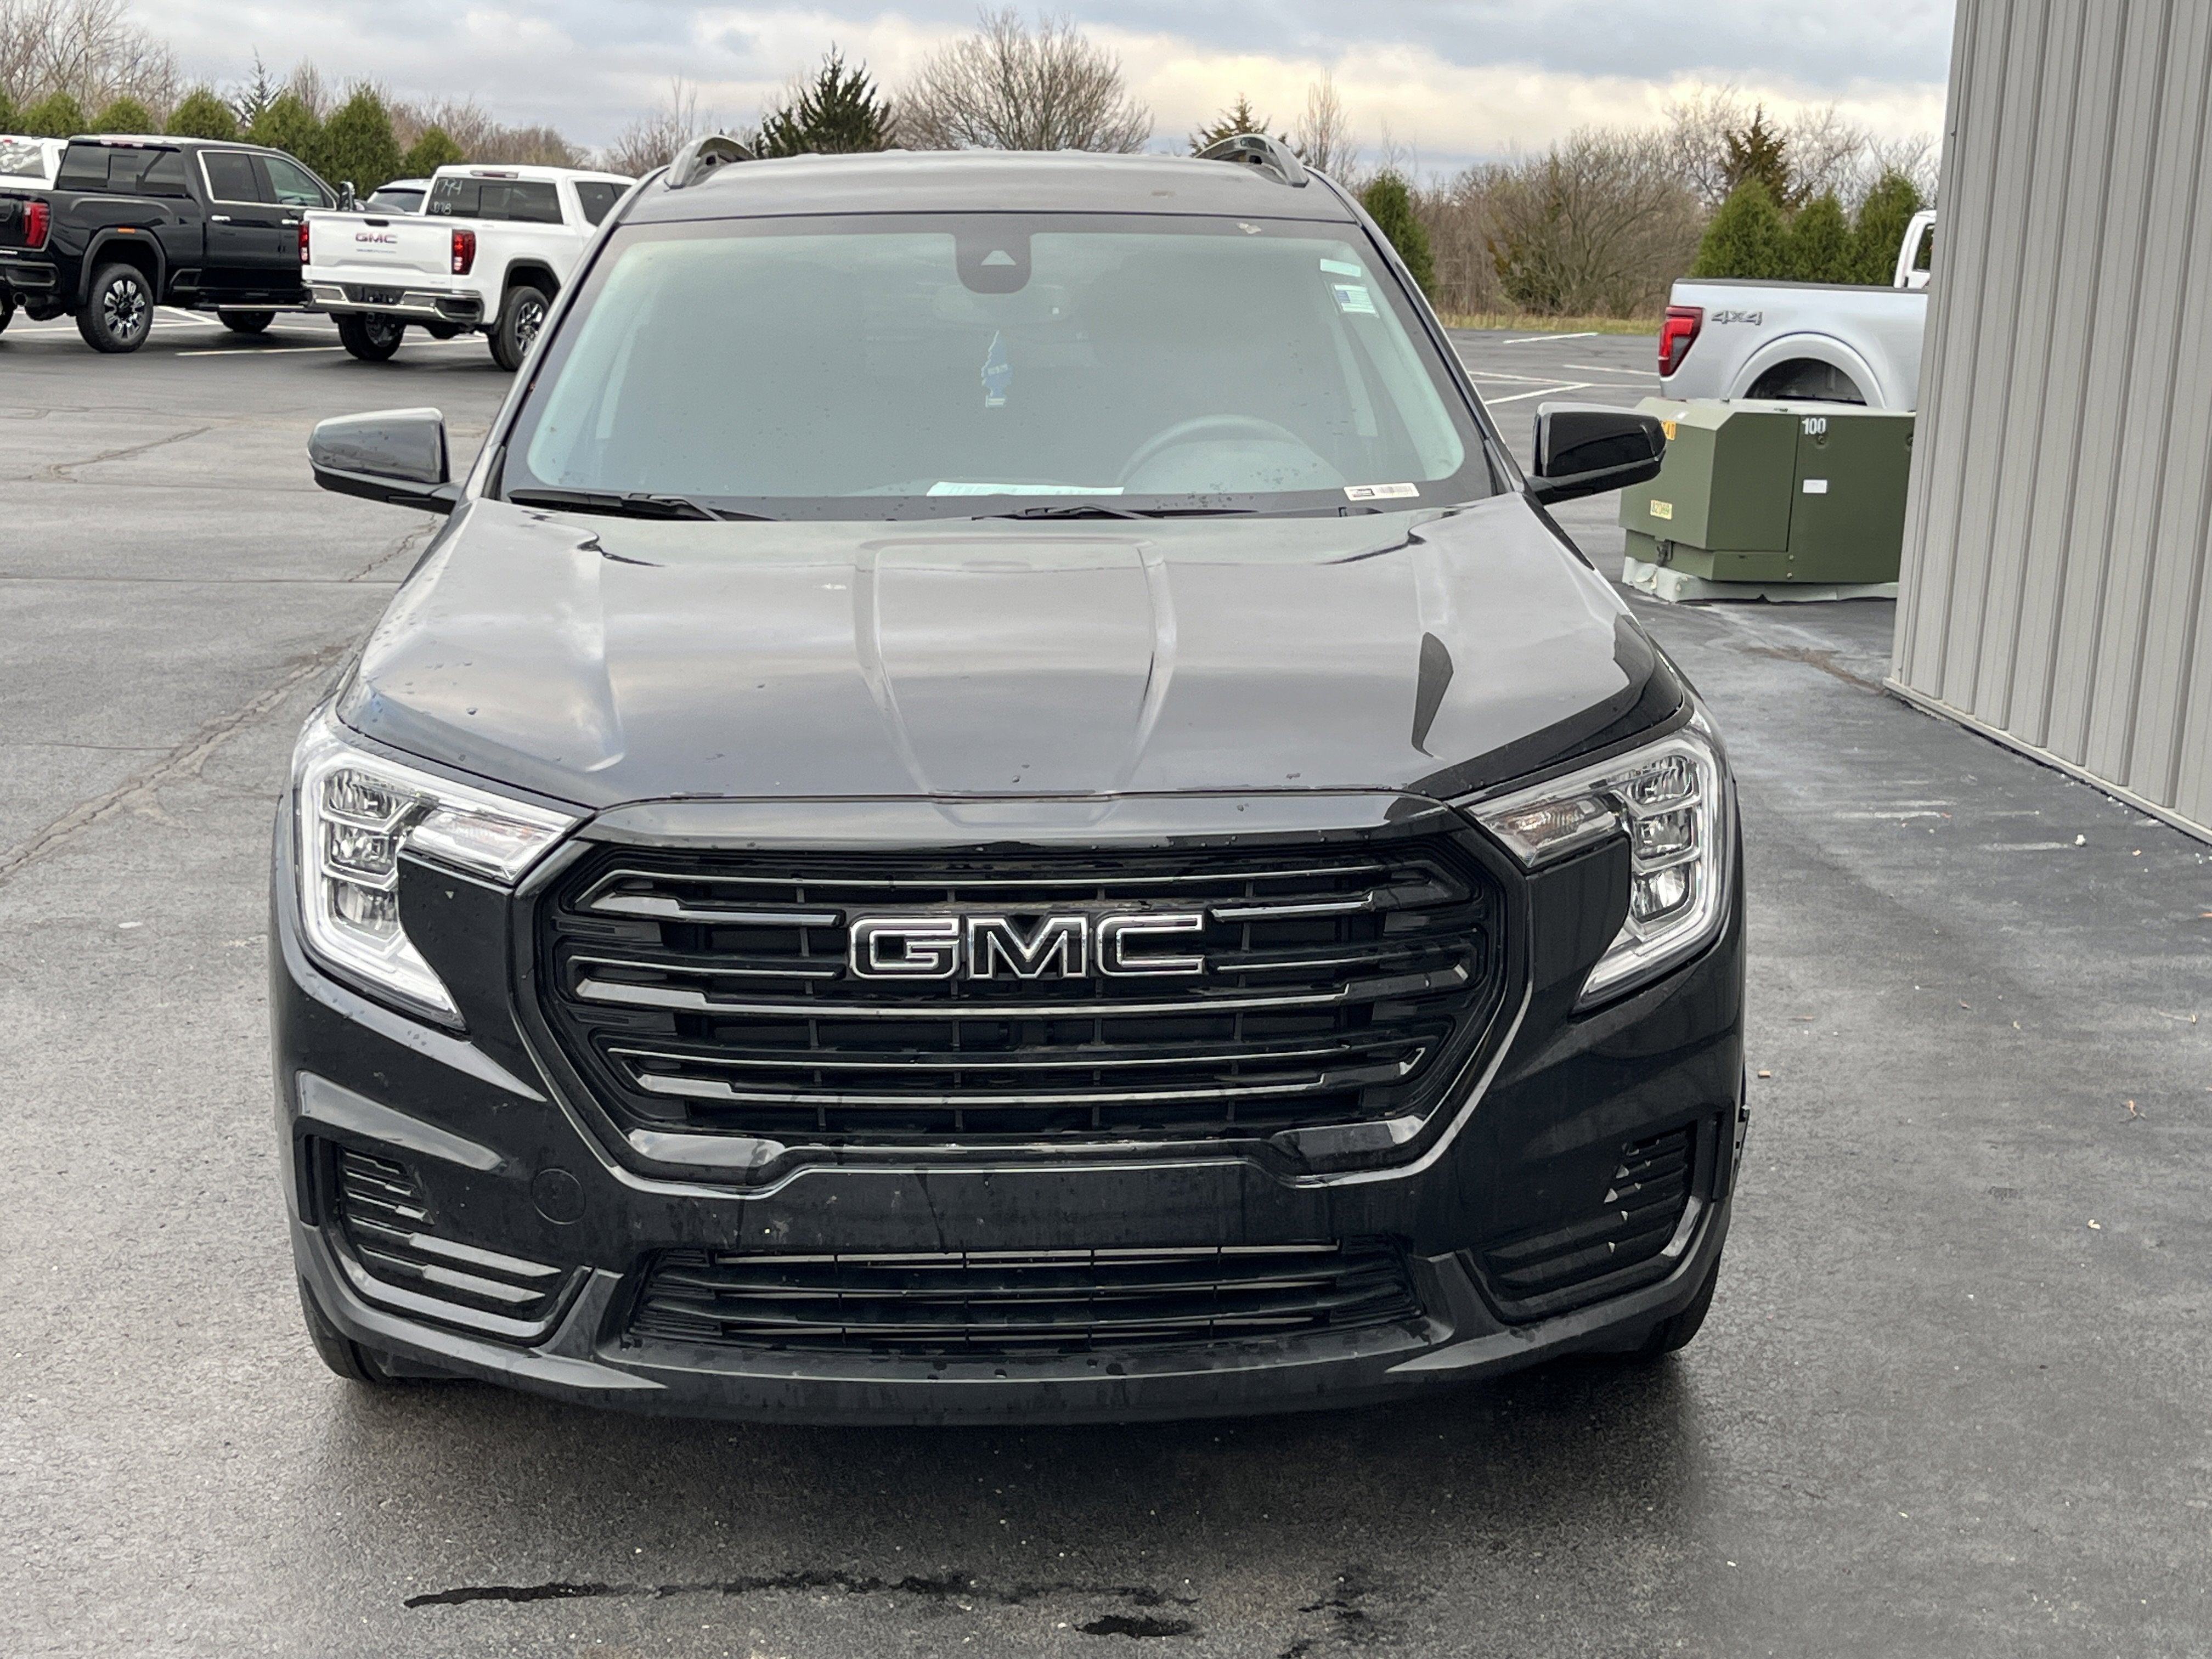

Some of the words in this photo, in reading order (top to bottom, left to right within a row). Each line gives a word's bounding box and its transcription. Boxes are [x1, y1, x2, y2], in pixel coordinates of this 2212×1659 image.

[355, 233, 398, 244] GMC
[1802, 417, 1826, 435] 100
[849, 916, 1205, 979] GMC
